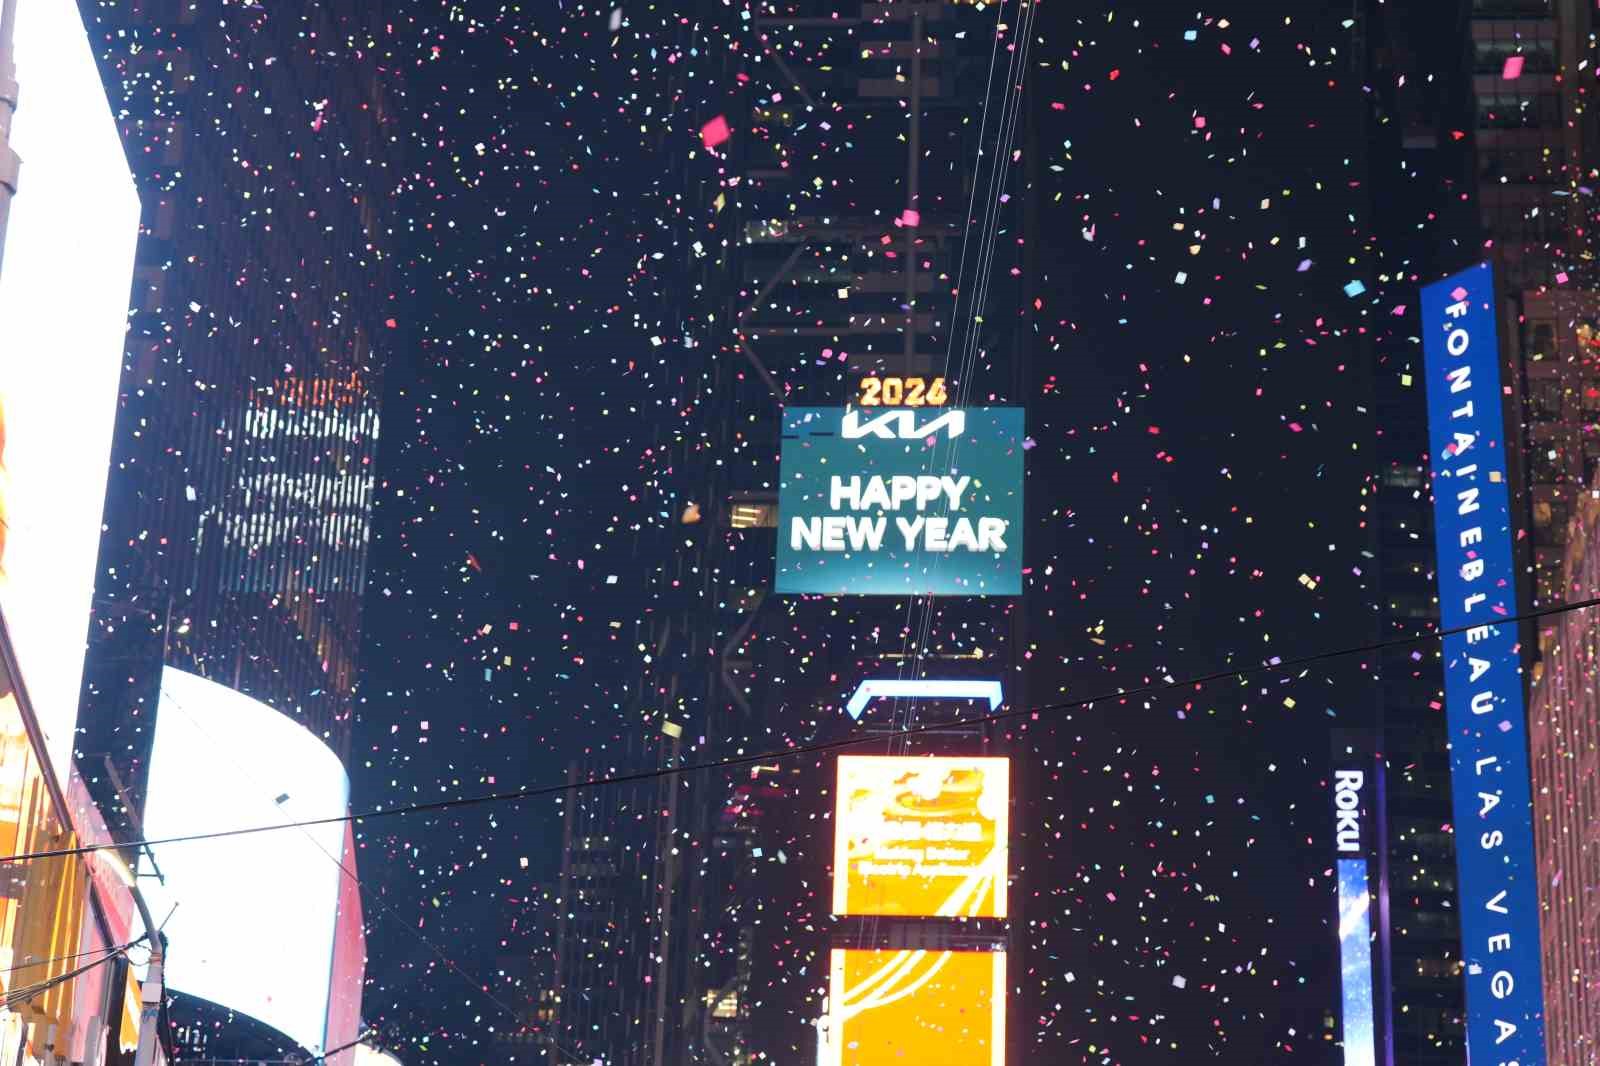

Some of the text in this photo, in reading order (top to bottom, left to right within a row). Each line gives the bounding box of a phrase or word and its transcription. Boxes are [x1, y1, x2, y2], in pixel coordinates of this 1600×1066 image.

[859, 377, 948, 406] 2026
[841, 410, 966, 438] KIA
[830, 475, 970, 510] HAPPY
[790, 516, 1008, 552] NEW YEAR
[1445, 301, 1494, 714] FONTAINEBLEAU
[1475, 756, 1503, 849] LAS
